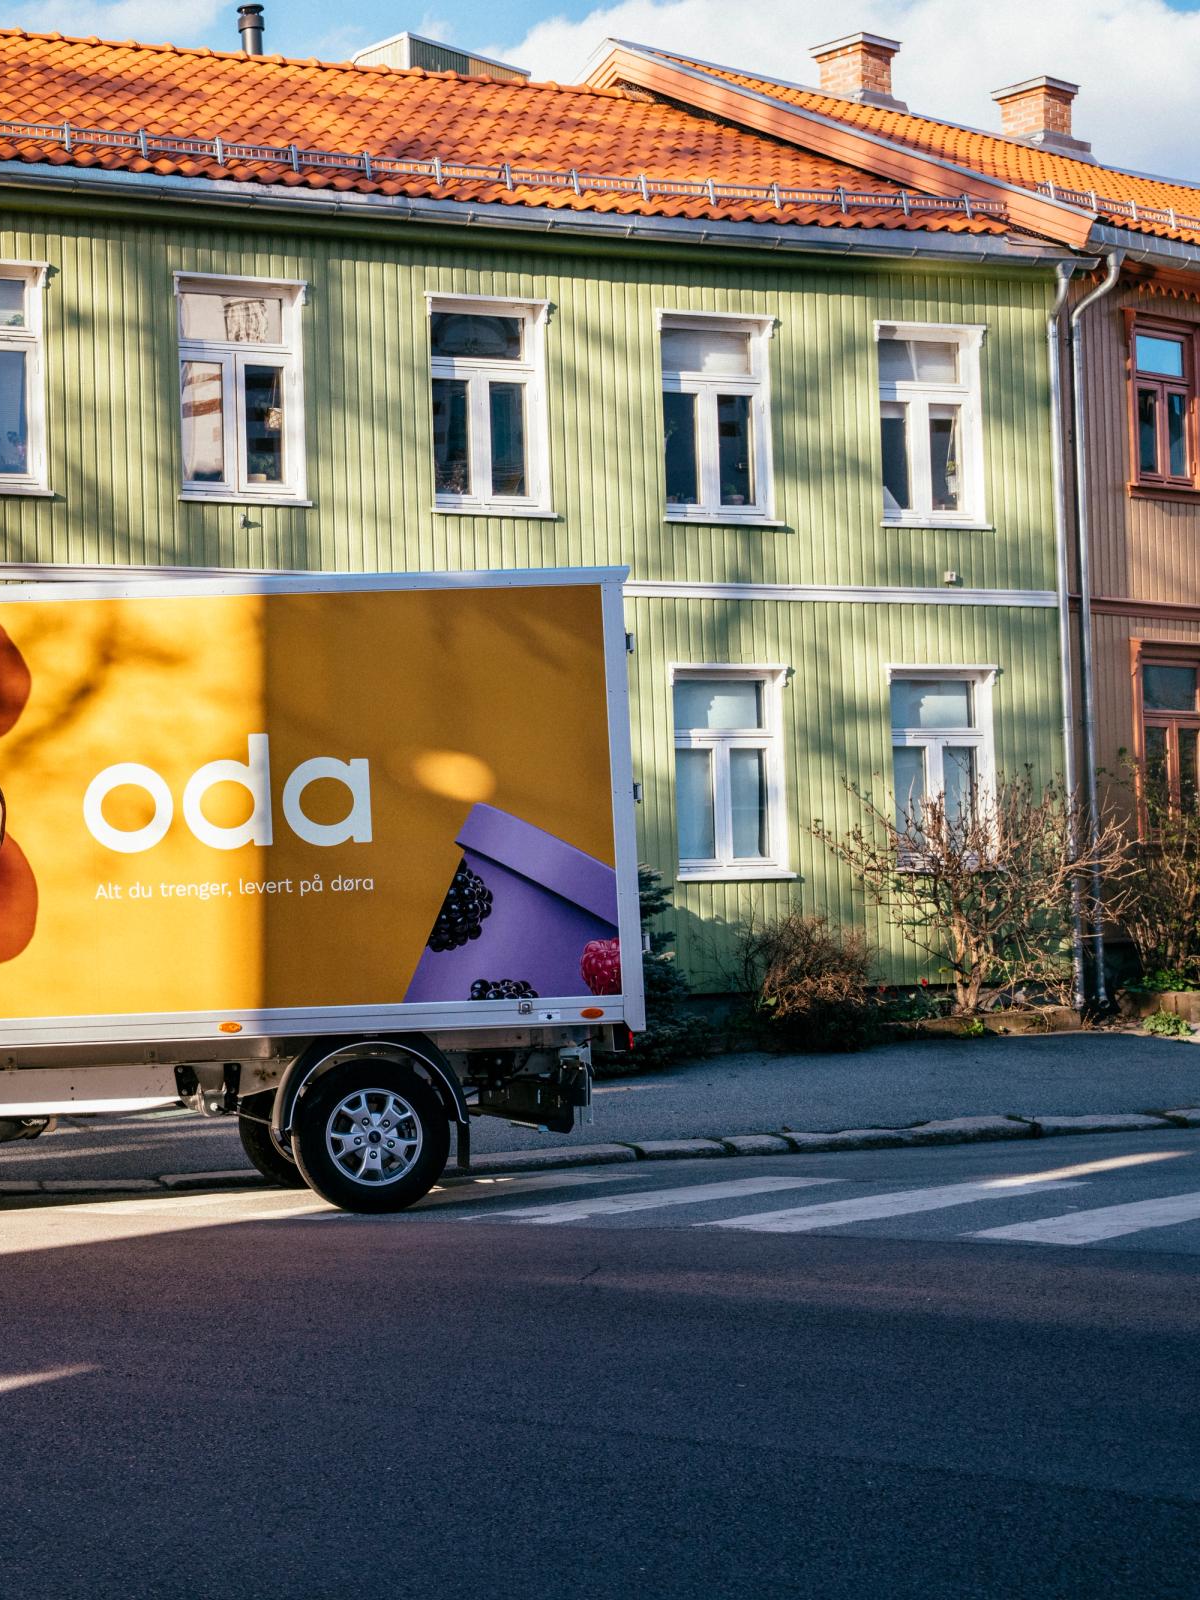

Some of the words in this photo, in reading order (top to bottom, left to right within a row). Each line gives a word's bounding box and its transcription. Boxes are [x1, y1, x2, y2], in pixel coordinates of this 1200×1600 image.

[82, 732, 374, 854] oda
[95, 882, 122, 900] Alt
[128, 881, 153, 899] du
[160, 881, 233, 900] trenger,
[239, 878, 293, 895] levert
[300, 874, 323, 896] på
[330, 875, 374, 892] døra
